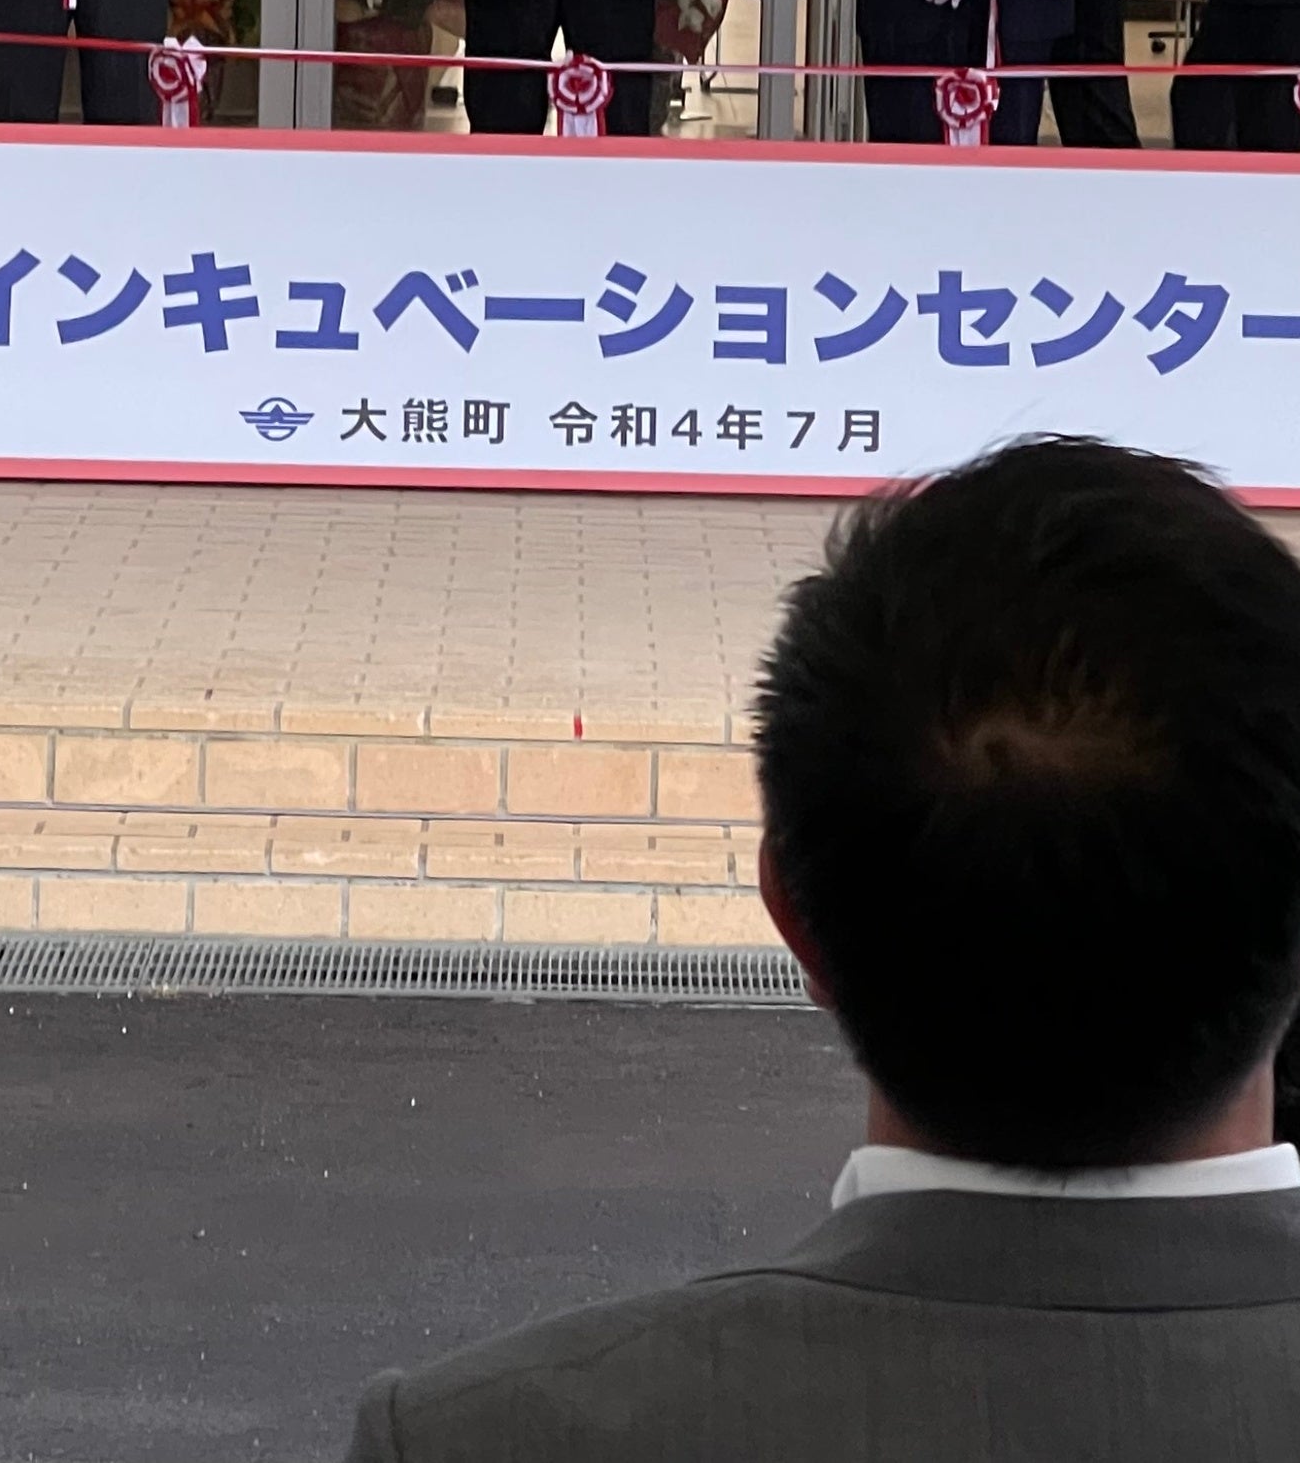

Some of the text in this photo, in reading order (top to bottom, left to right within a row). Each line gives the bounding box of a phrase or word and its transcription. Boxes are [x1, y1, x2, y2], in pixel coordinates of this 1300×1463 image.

[339, 397, 882, 453] 大熊町 令和4年7月
